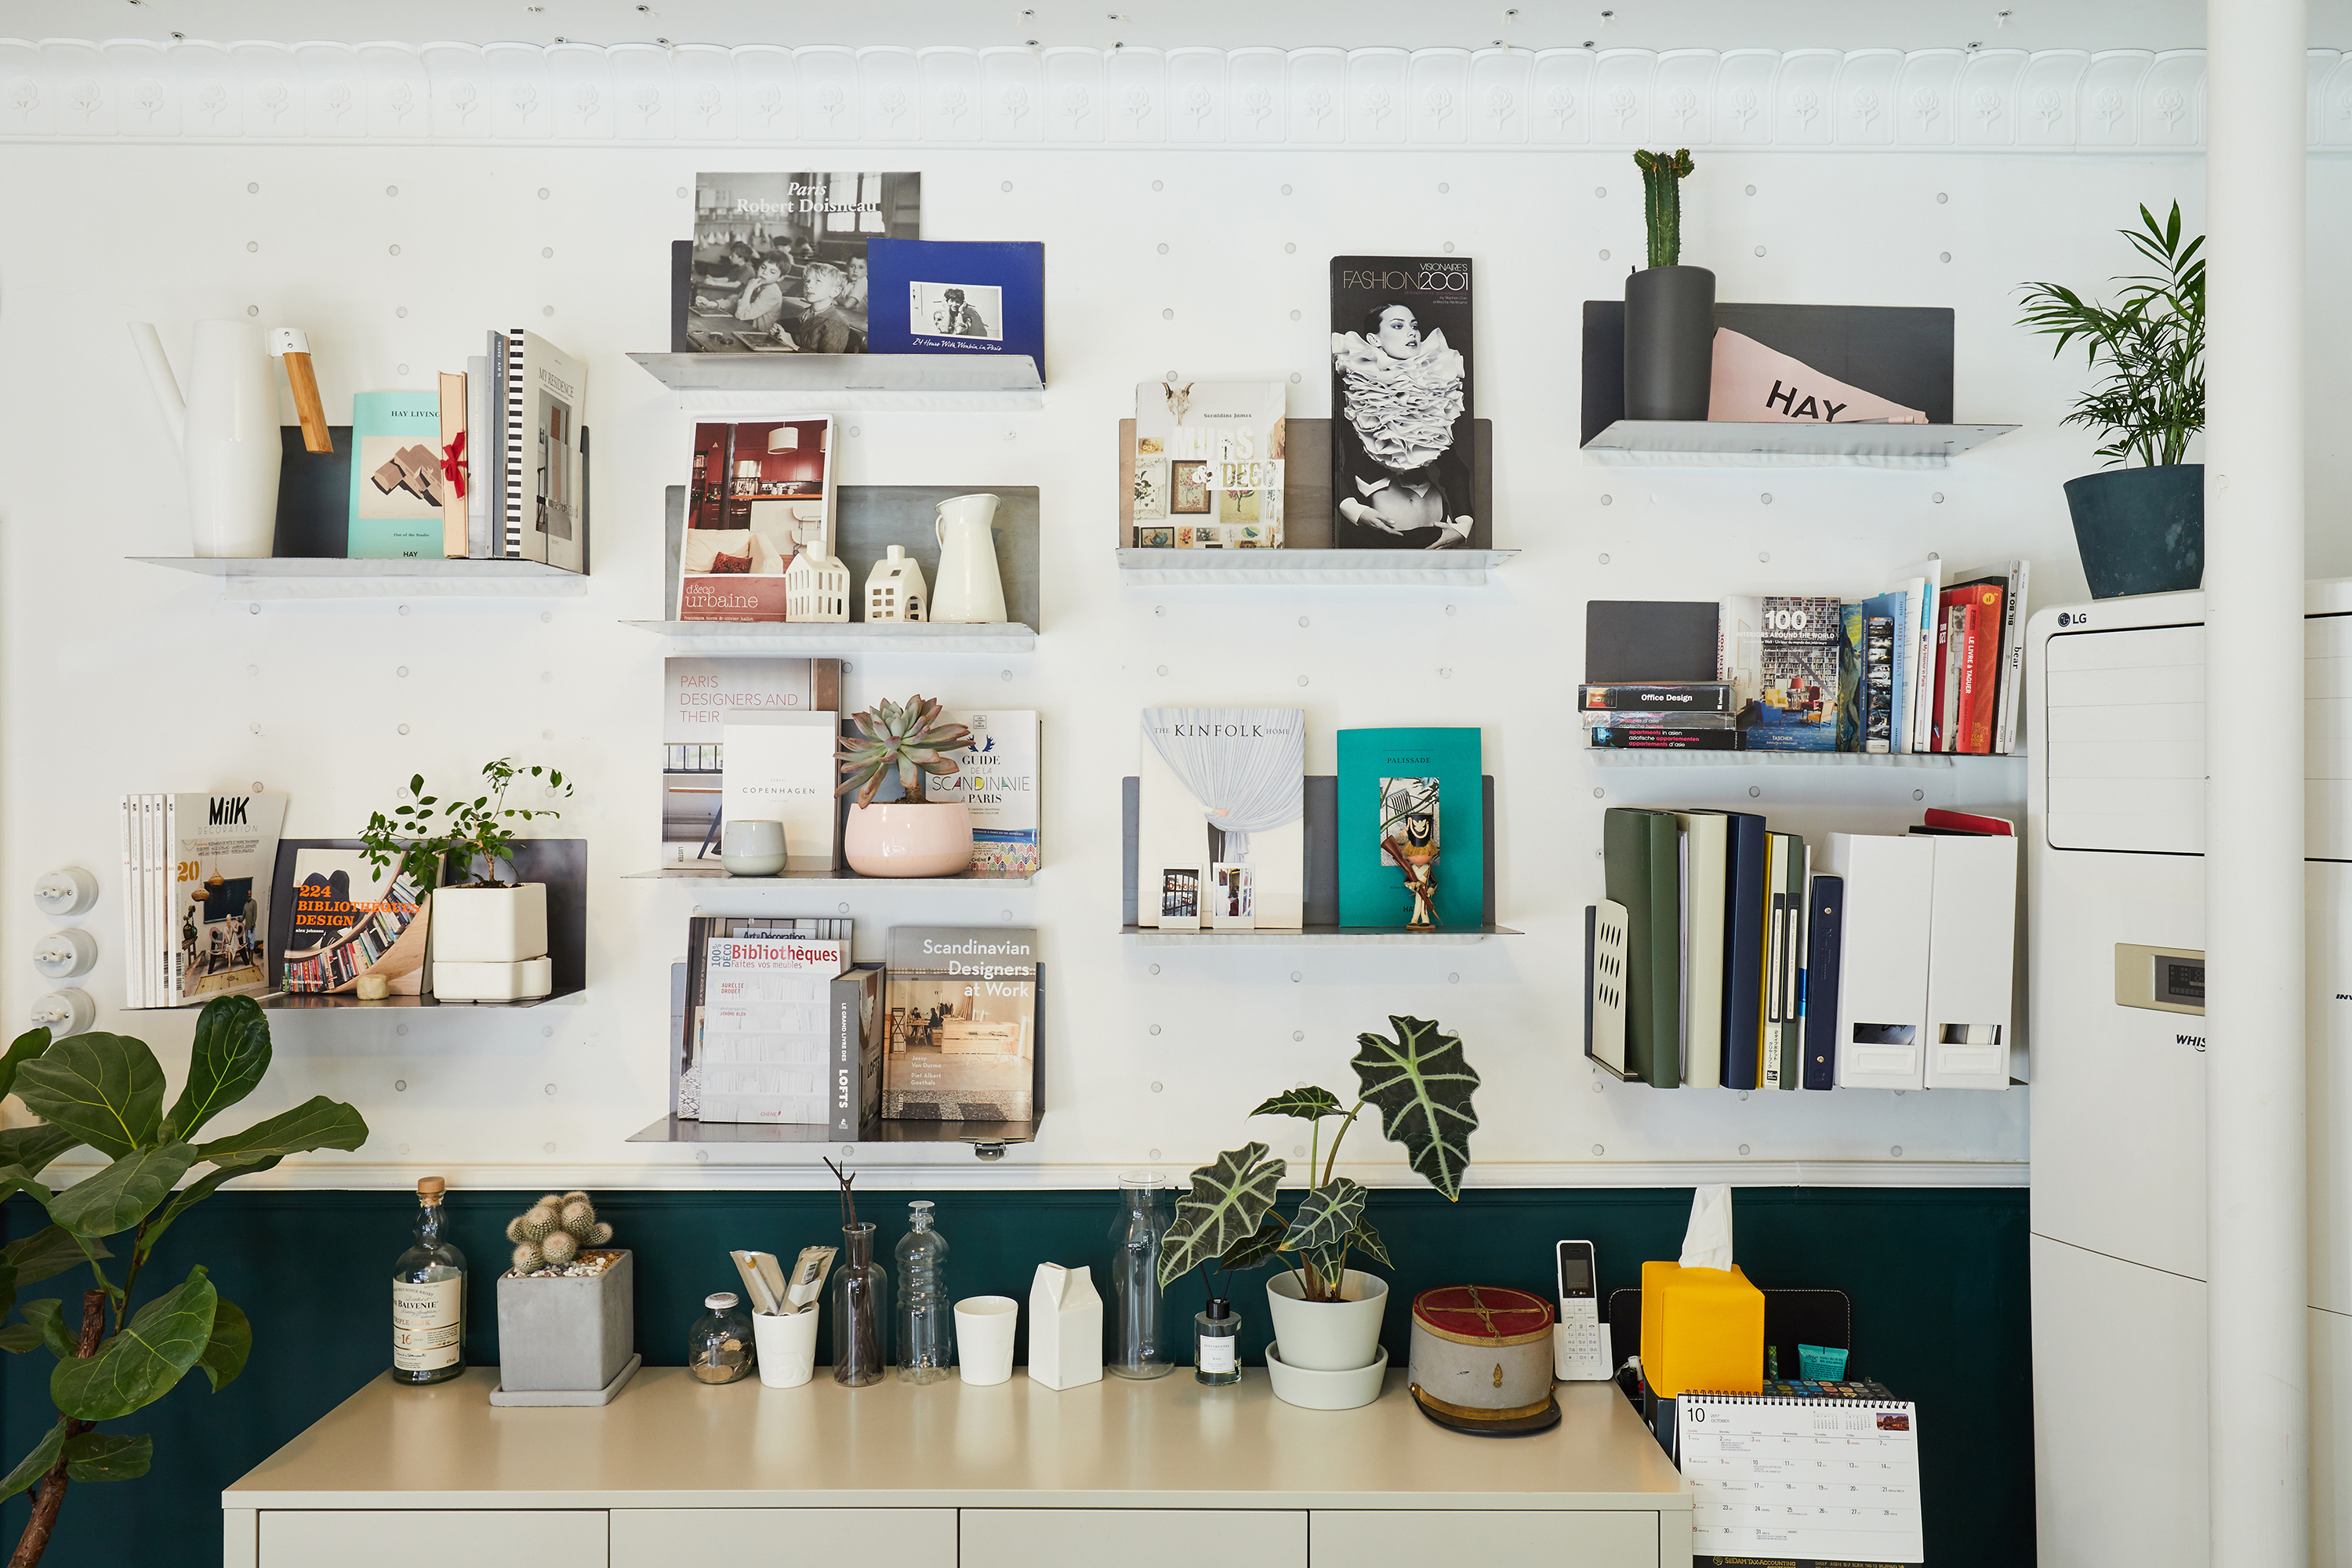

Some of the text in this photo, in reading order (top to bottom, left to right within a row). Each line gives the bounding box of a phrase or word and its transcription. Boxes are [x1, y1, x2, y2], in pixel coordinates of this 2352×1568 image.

[787, 181, 827, 196] Paris
[736, 198, 877, 212] Robert Doisneau
[1343, 270, 1468, 291] FASHION 2001
[539, 367, 548, 382] MY
[547, 372, 574, 398] RESIDENCE
[1766, 379, 1847, 423] HAY
[685, 592, 758, 608] urbaine
[1765, 610, 1807, 630] 100
[2072, 614, 2087, 625] LG
[1969, 636, 1975, 644] LE
[2013, 646, 2022, 669] bear
[681, 675, 718, 688] PARIS
[681, 693, 798, 706] DESIGNERS AND
[1666, 694, 1693, 702] Design
[679, 710, 720, 723] THEIR
[1174, 724, 1263, 737] KINFOLK
[962, 755, 1001, 765] GUIDE
[1387, 757, 1432, 765] PALISSADE
[931, 776, 1030, 791] SCANDINAVIE
[968, 793, 1002, 804] PARIS
[209, 796, 250, 826] MilK
[198, 825, 259, 835] DECORATION
[176, 860, 200, 883] 20
[299, 884, 332, 898] 224
[297, 898, 420, 914] BIBLIOTHÈQUES
[296, 915, 355, 926] DESIGN
[922, 938, 1030, 955] Scandinavian
[711, 943, 721, 967] 100%
[721, 943, 732, 967] DÉCO
[731, 944, 838, 965] Bibliothèques
[731, 960, 755, 968] Faites
[949, 960, 1029, 980] Designers
[964, 982, 1029, 997] at Work
[867, 1055, 880, 1080] LOFTS
[838, 1069, 848, 1109] LOFTS
[397, 1299, 437, 1309] BALVENIE
[401, 1334, 412, 1345] 16
[1687, 1407, 1705, 1423] 10
